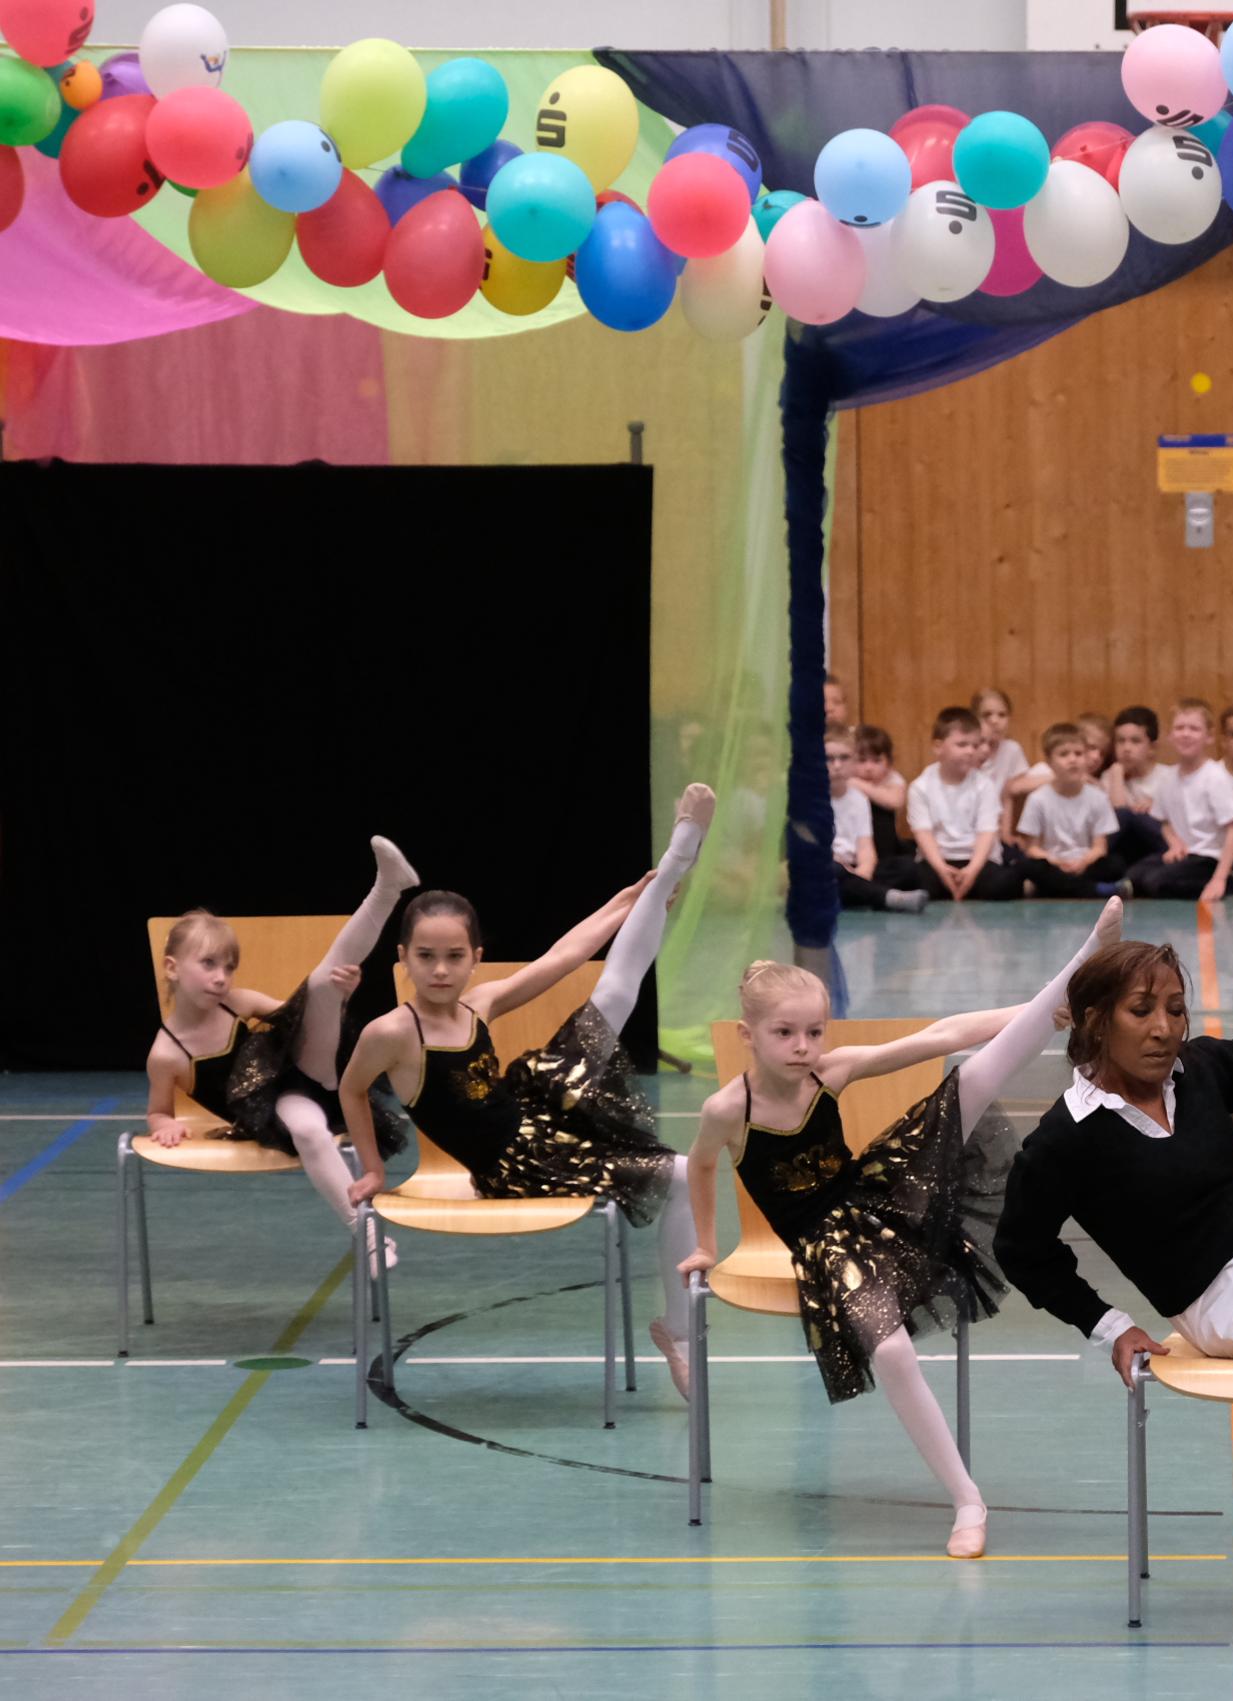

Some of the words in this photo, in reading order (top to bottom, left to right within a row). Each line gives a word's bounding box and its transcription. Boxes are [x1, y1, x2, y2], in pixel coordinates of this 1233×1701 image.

[537, 109, 567, 149] S
[1172, 135, 1213, 168] S
[936, 191, 977, 222] S
